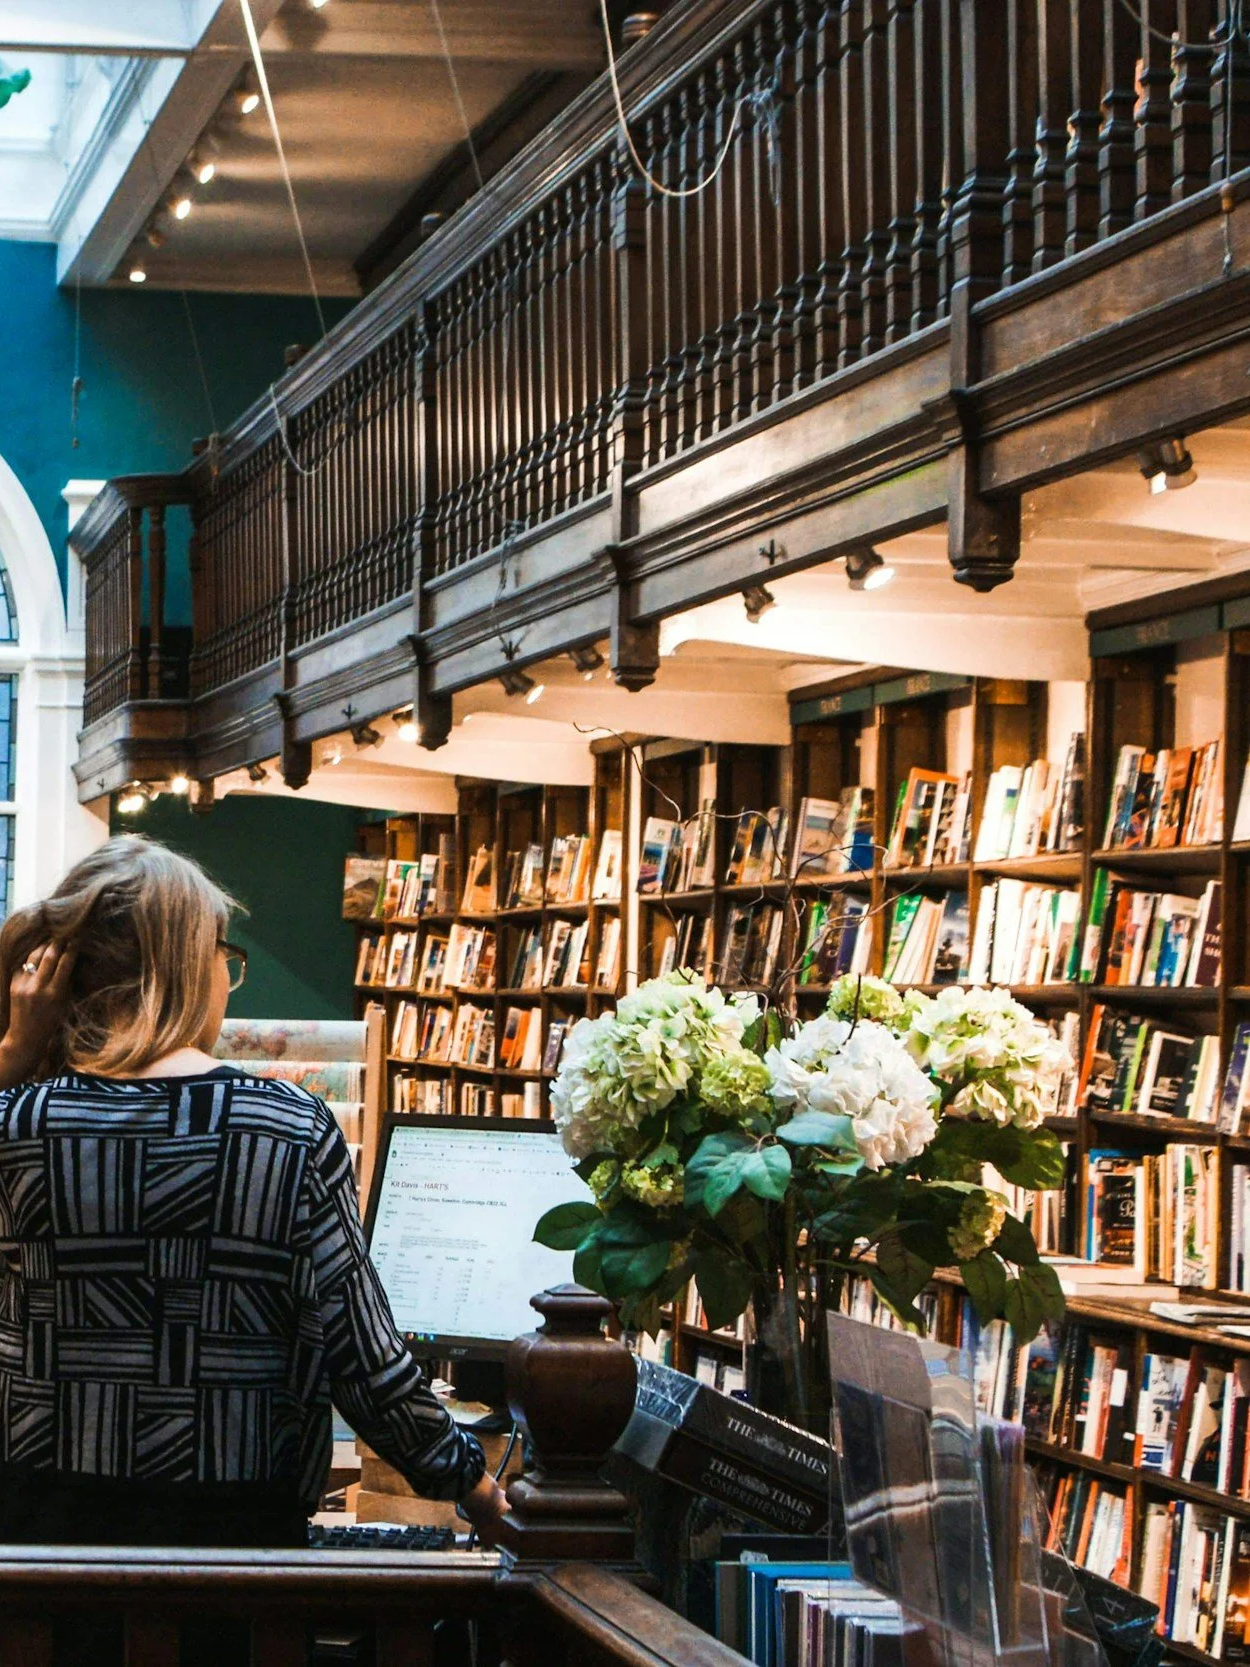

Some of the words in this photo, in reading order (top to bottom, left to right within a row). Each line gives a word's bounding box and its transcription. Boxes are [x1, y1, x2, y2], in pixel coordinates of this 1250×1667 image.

[726, 1417, 756, 1438] THE
[787, 1445, 830, 1475] TIMES
[702, 1472, 808, 1532] COMPREHENSIVE
[709, 1458, 739, 1481] THE
[771, 1486, 814, 1517] TIMES
